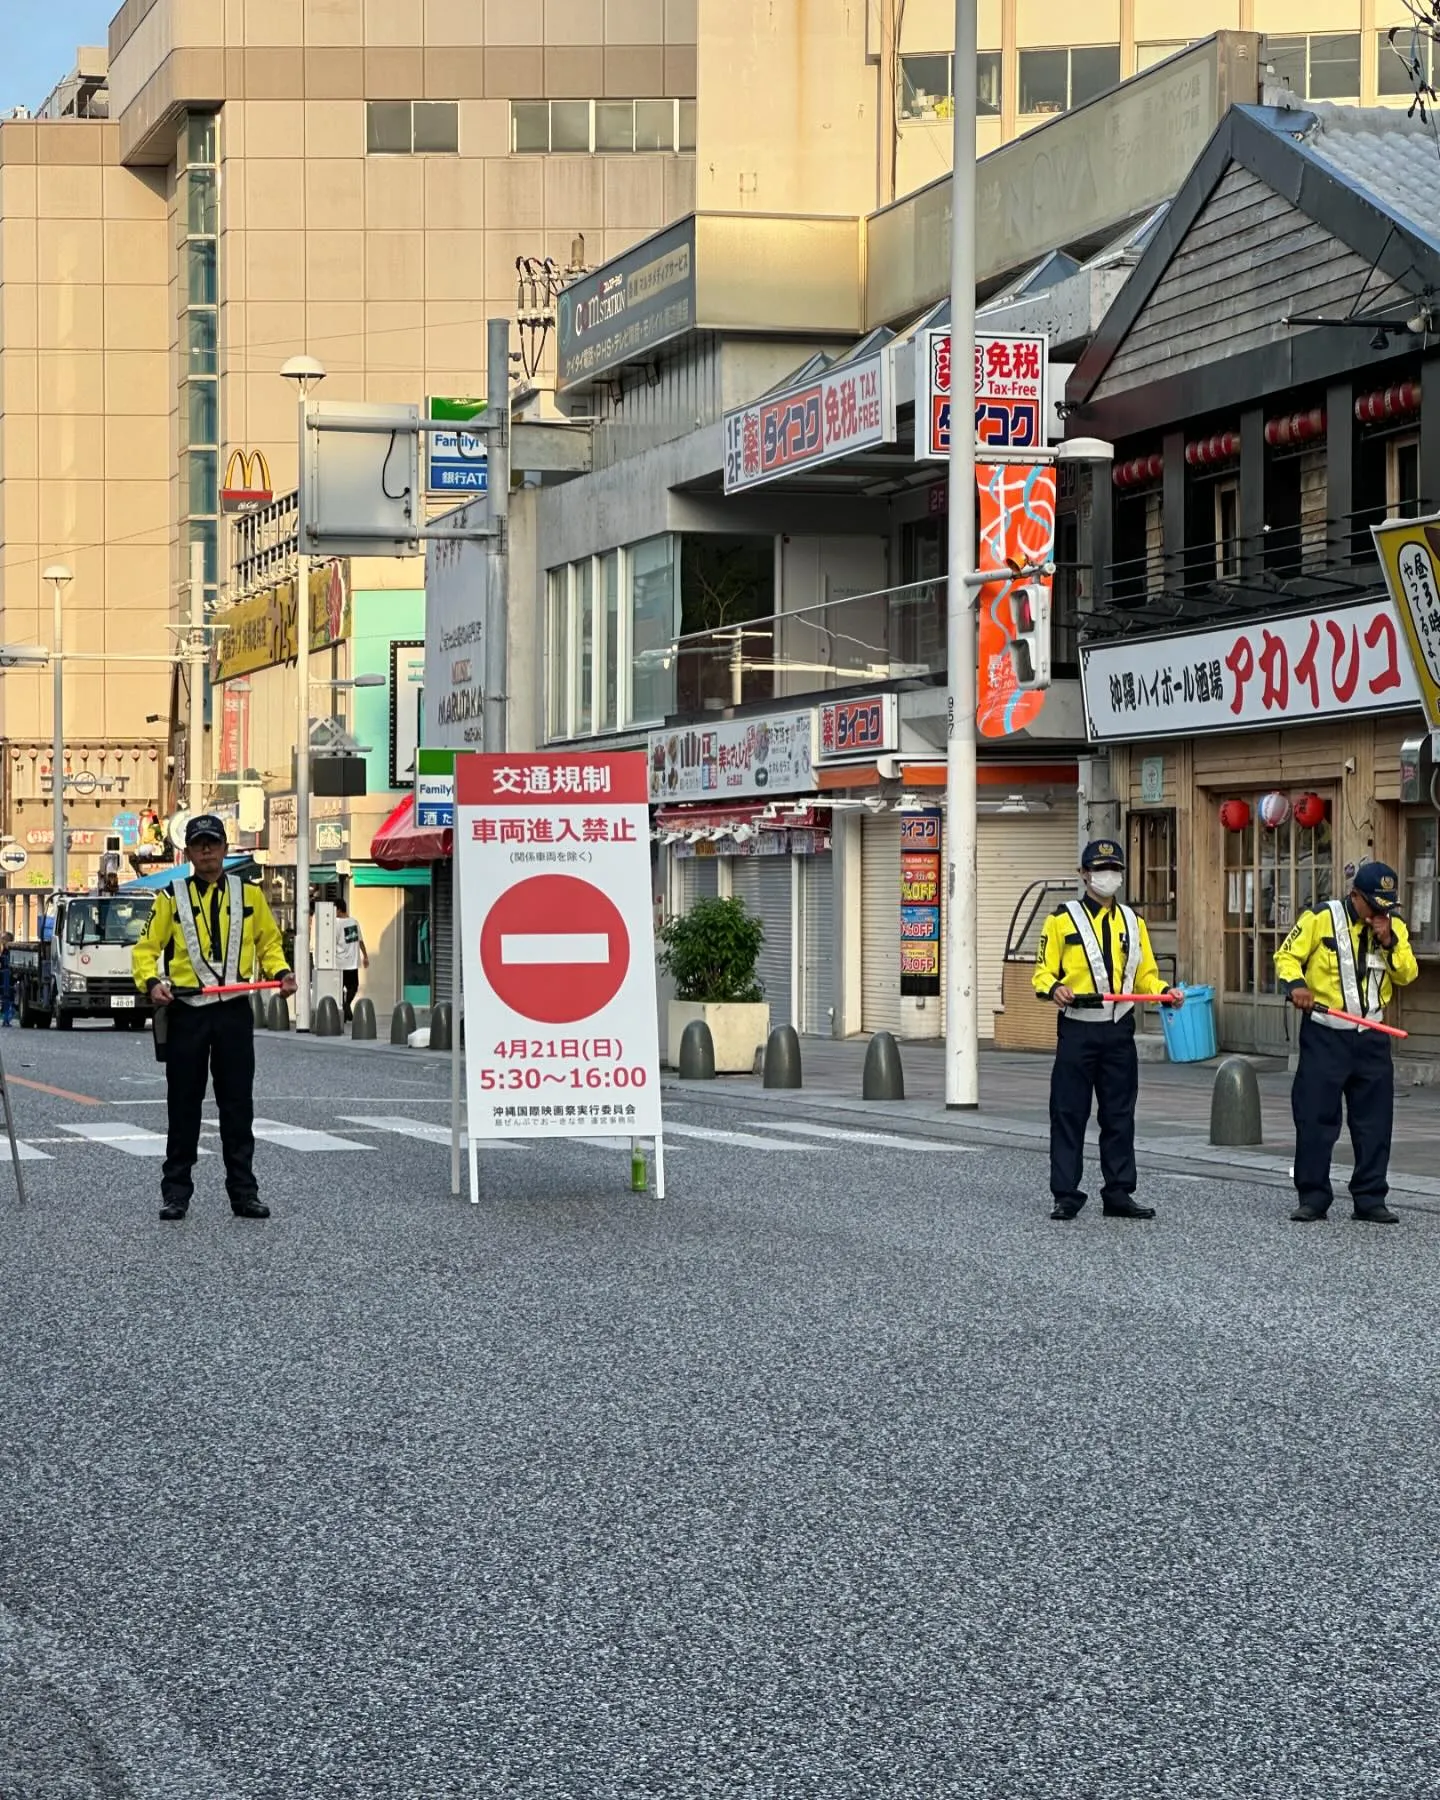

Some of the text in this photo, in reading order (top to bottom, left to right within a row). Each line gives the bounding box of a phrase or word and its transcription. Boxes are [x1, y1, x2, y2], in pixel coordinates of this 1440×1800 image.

[986, 341, 1040, 379] 免税
[859, 370, 877, 401] TAX
[987, 381, 1037, 396] Tax-Free
[727, 416, 741, 446] 1F
[764, 394, 821, 464] ダイコク
[825, 380, 858, 445] 免税
[858, 406, 880, 433] FREE
[442, 471, 487, 485] 銀行AT
[727, 450, 742, 484] 2F
[1109, 659, 1224, 714] 沖縄ハイボール酒場
[1225, 612, 1402, 716] アカインコ
[437, 685, 484, 727] MARUTAKA
[837, 705, 880, 746] ダイコク
[420, 784, 454, 797] Family
[492, 766, 612, 796] 交通規制
[471, 817, 637, 844] 車両進入禁止
[509, 850, 593, 865] (関係車両を除く)
[493, 1038, 624, 1060] 4月21日(日)
[480, 1066, 647, 1090] 5:30〜16:00
[493, 1103, 636, 1117] 沖縄国際映画祭実行委員会
